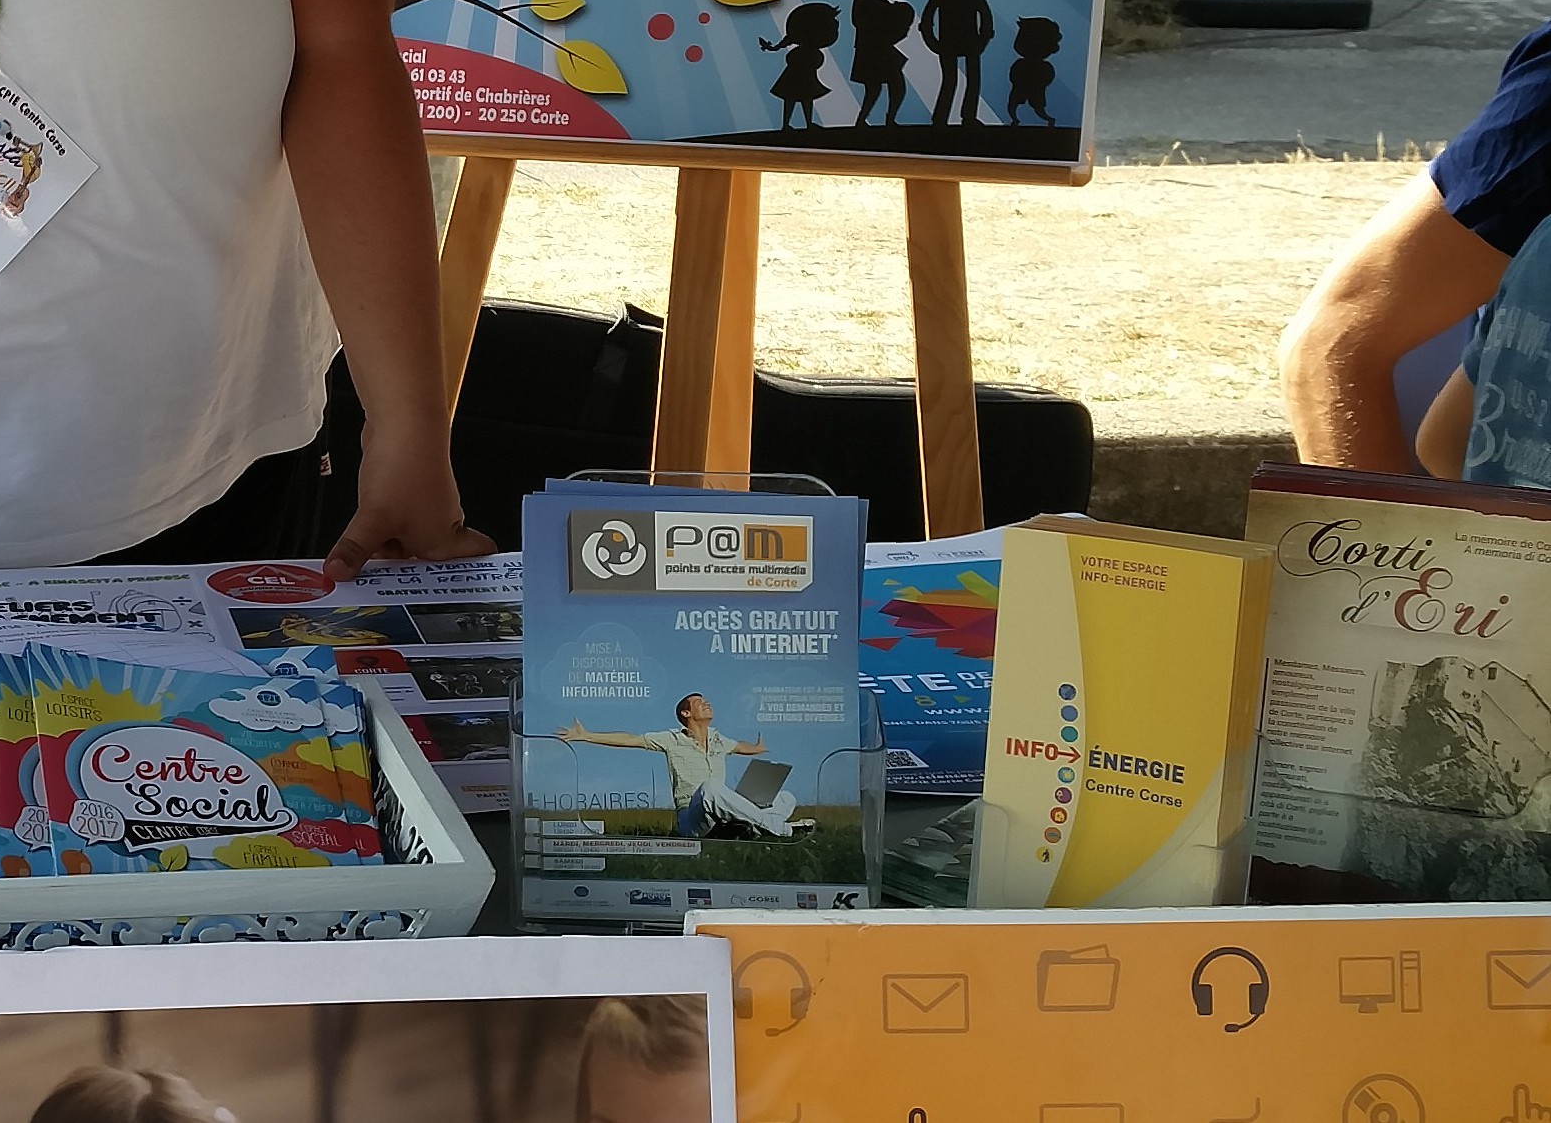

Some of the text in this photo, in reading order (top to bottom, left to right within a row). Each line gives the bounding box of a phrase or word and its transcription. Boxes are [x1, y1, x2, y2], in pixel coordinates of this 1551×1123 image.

[410, 68, 466, 84] 61 03 43
[414, 87, 551, 106] portif de Chabrières
[427, 105, 570, 125] 200) 20 250 Corte
[19, 103, 46, 131] Centre
[45, 129, 67, 156] Corse
[1277, 519, 1439, 578] Corti
[1455, 532, 1468, 542] La
[1520, 539, 1534, 549] de
[1464, 545, 1536, 561] A memoria di
[665, 564, 807, 576] points d'accès multimédia
[1080, 556, 1168, 577] VOTRE ESPACE
[247, 576, 296, 586] CEL
[747, 578, 798, 588] de Corte
[1080, 571, 1166, 592] INFO-ENERGIE
[675, 605, 840, 631] ACCÈS GRATUIT
[586, 640, 622, 654] MISE À
[710, 629, 724, 653] À
[572, 657, 639, 670] DISPOSITION
[569, 669, 643, 683] DE MATÉRIEL
[61, 693, 95, 707] ESPACE
[562, 686, 651, 699] INFORMATIQUE
[47, 703, 103, 722] LOISIRS
[1005, 737, 1059, 761] INFO
[92, 744, 251, 785] Centre
[1088, 745, 1186, 784] ÉNERGIE
[544, 792, 649, 810] HORAIRES
[1085, 779, 1183, 809] Centre Corse
[80, 802, 114, 819] 2016
[125, 783, 292, 826] Social
[77, 816, 118, 839] 2017
[132, 825, 192, 840] CENTRE
[291, 829, 341, 847] SOCIAL
